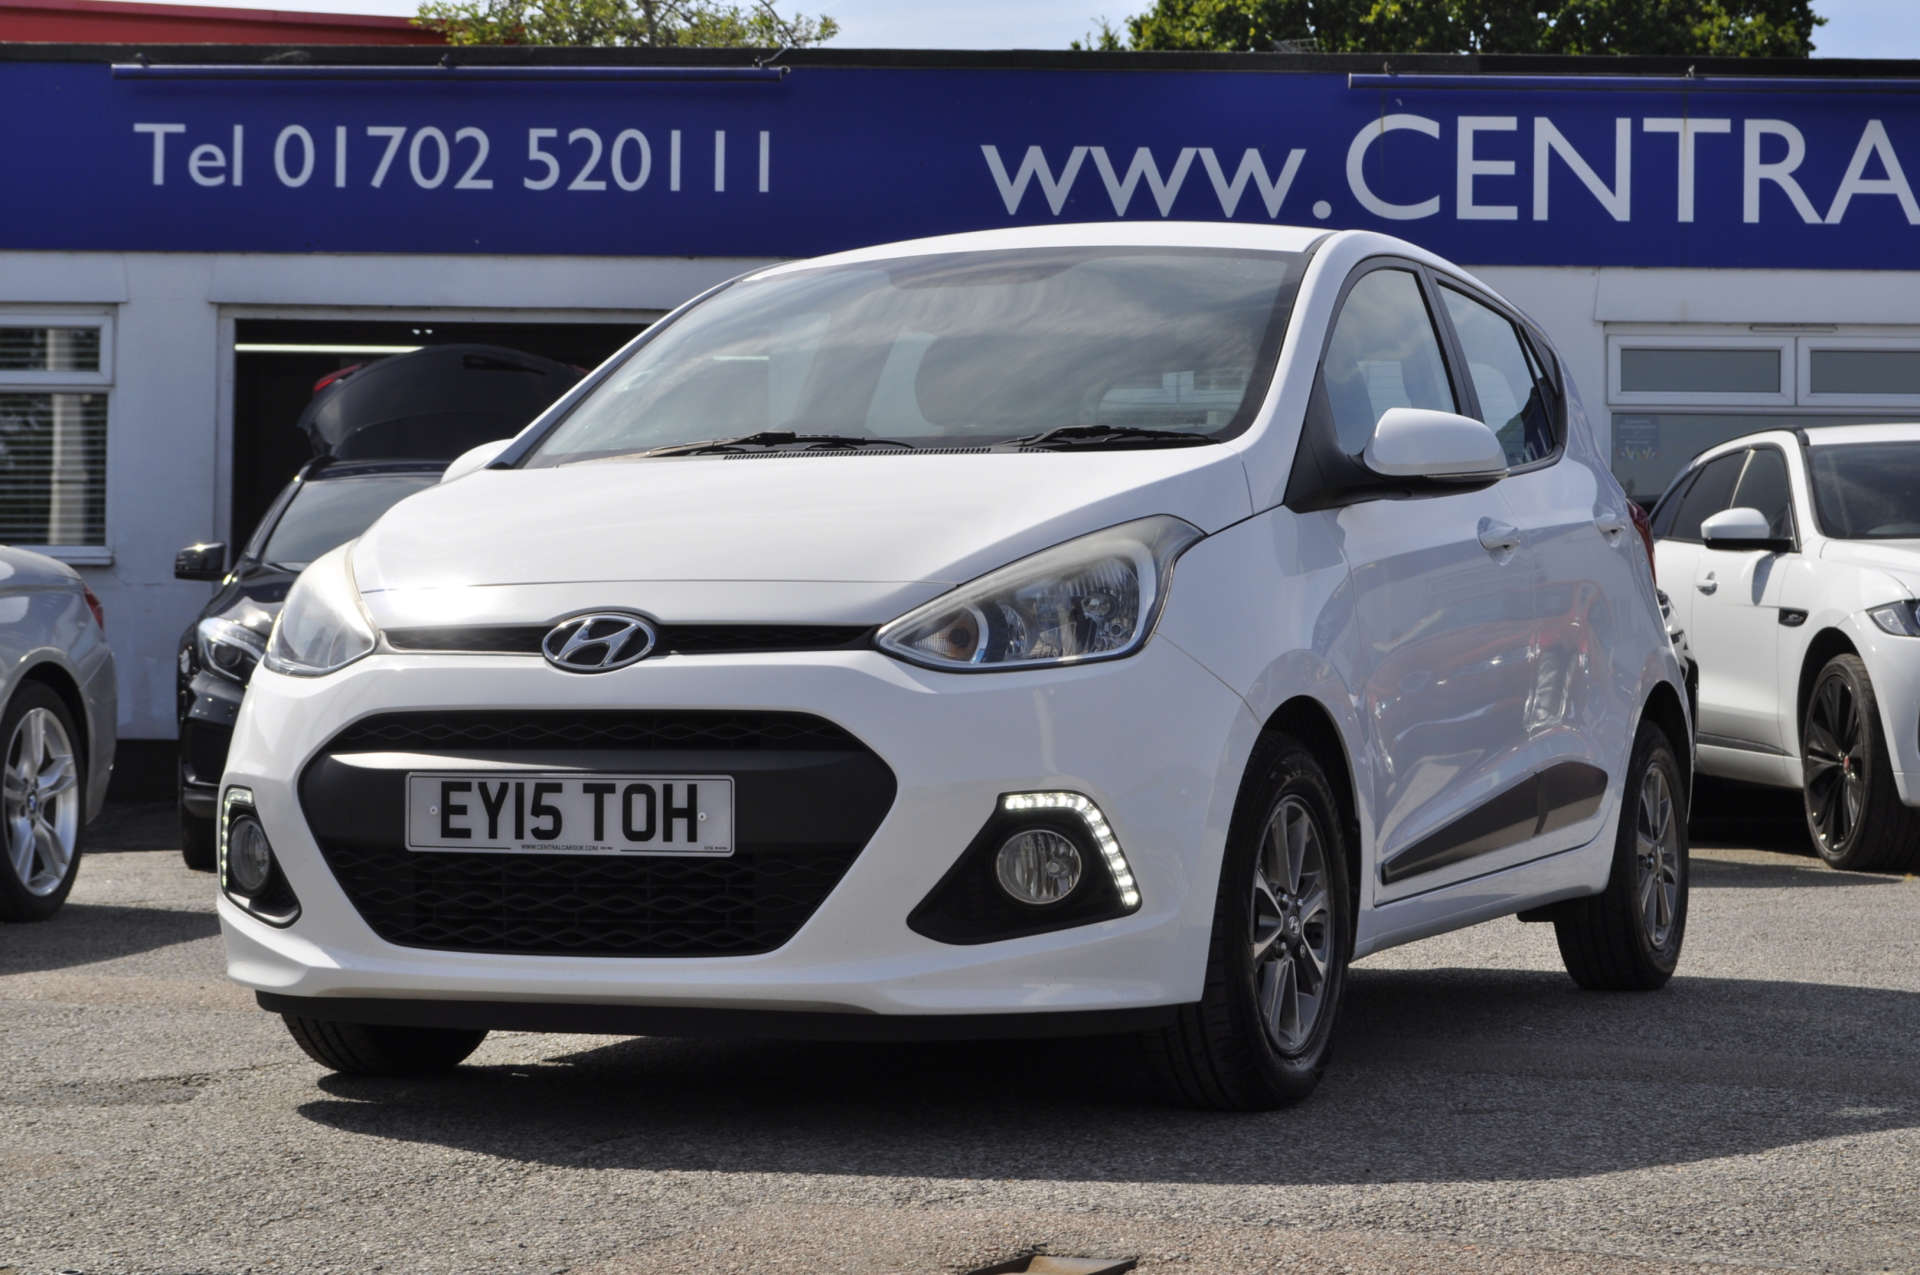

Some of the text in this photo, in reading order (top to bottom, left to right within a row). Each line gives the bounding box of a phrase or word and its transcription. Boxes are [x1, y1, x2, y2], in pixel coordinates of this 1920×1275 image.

[133, 123, 770, 193] Tel 01702 520111
[440, 780, 698, 843] EY15 TOH
